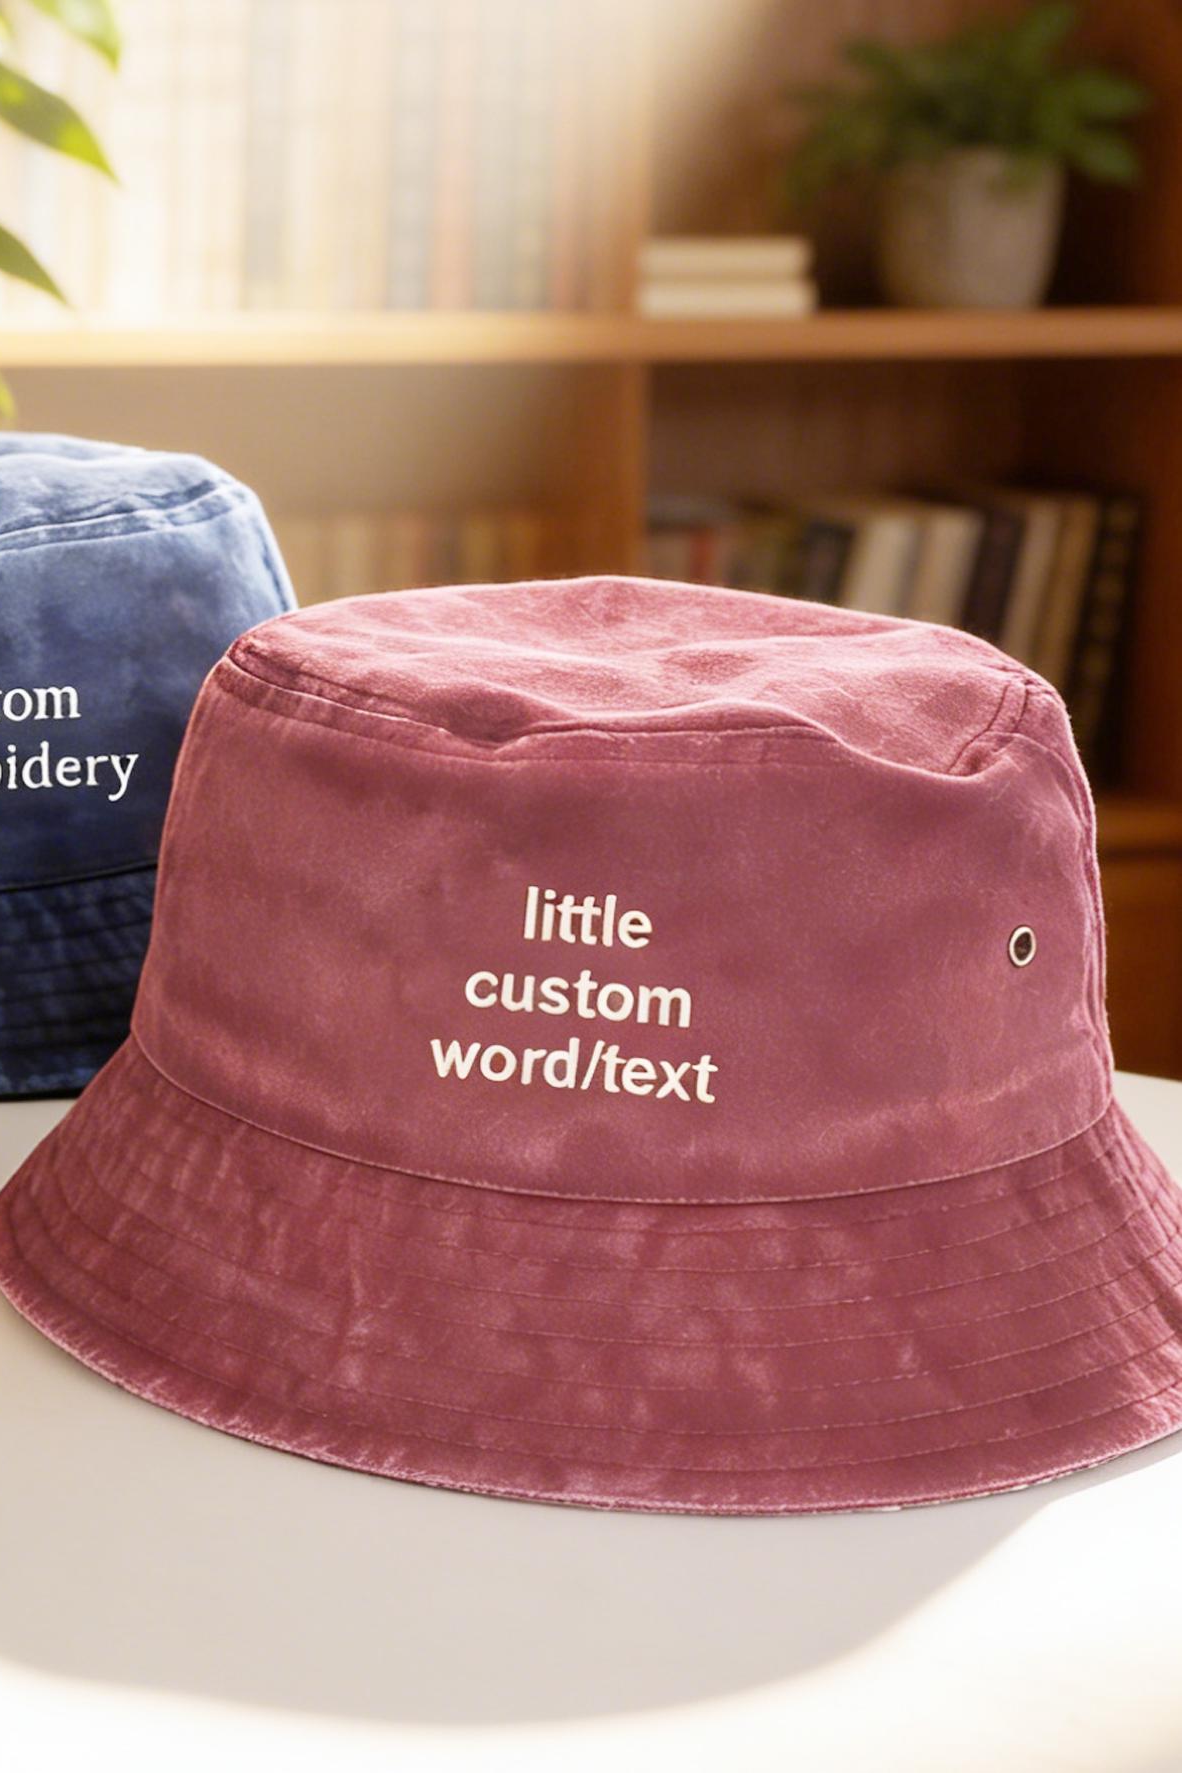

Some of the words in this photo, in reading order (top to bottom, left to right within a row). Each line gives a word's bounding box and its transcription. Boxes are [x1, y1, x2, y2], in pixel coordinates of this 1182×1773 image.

[523, 886, 653, 949] little
[465, 969, 692, 1028] custom
[430, 1037, 719, 1104] word/text
